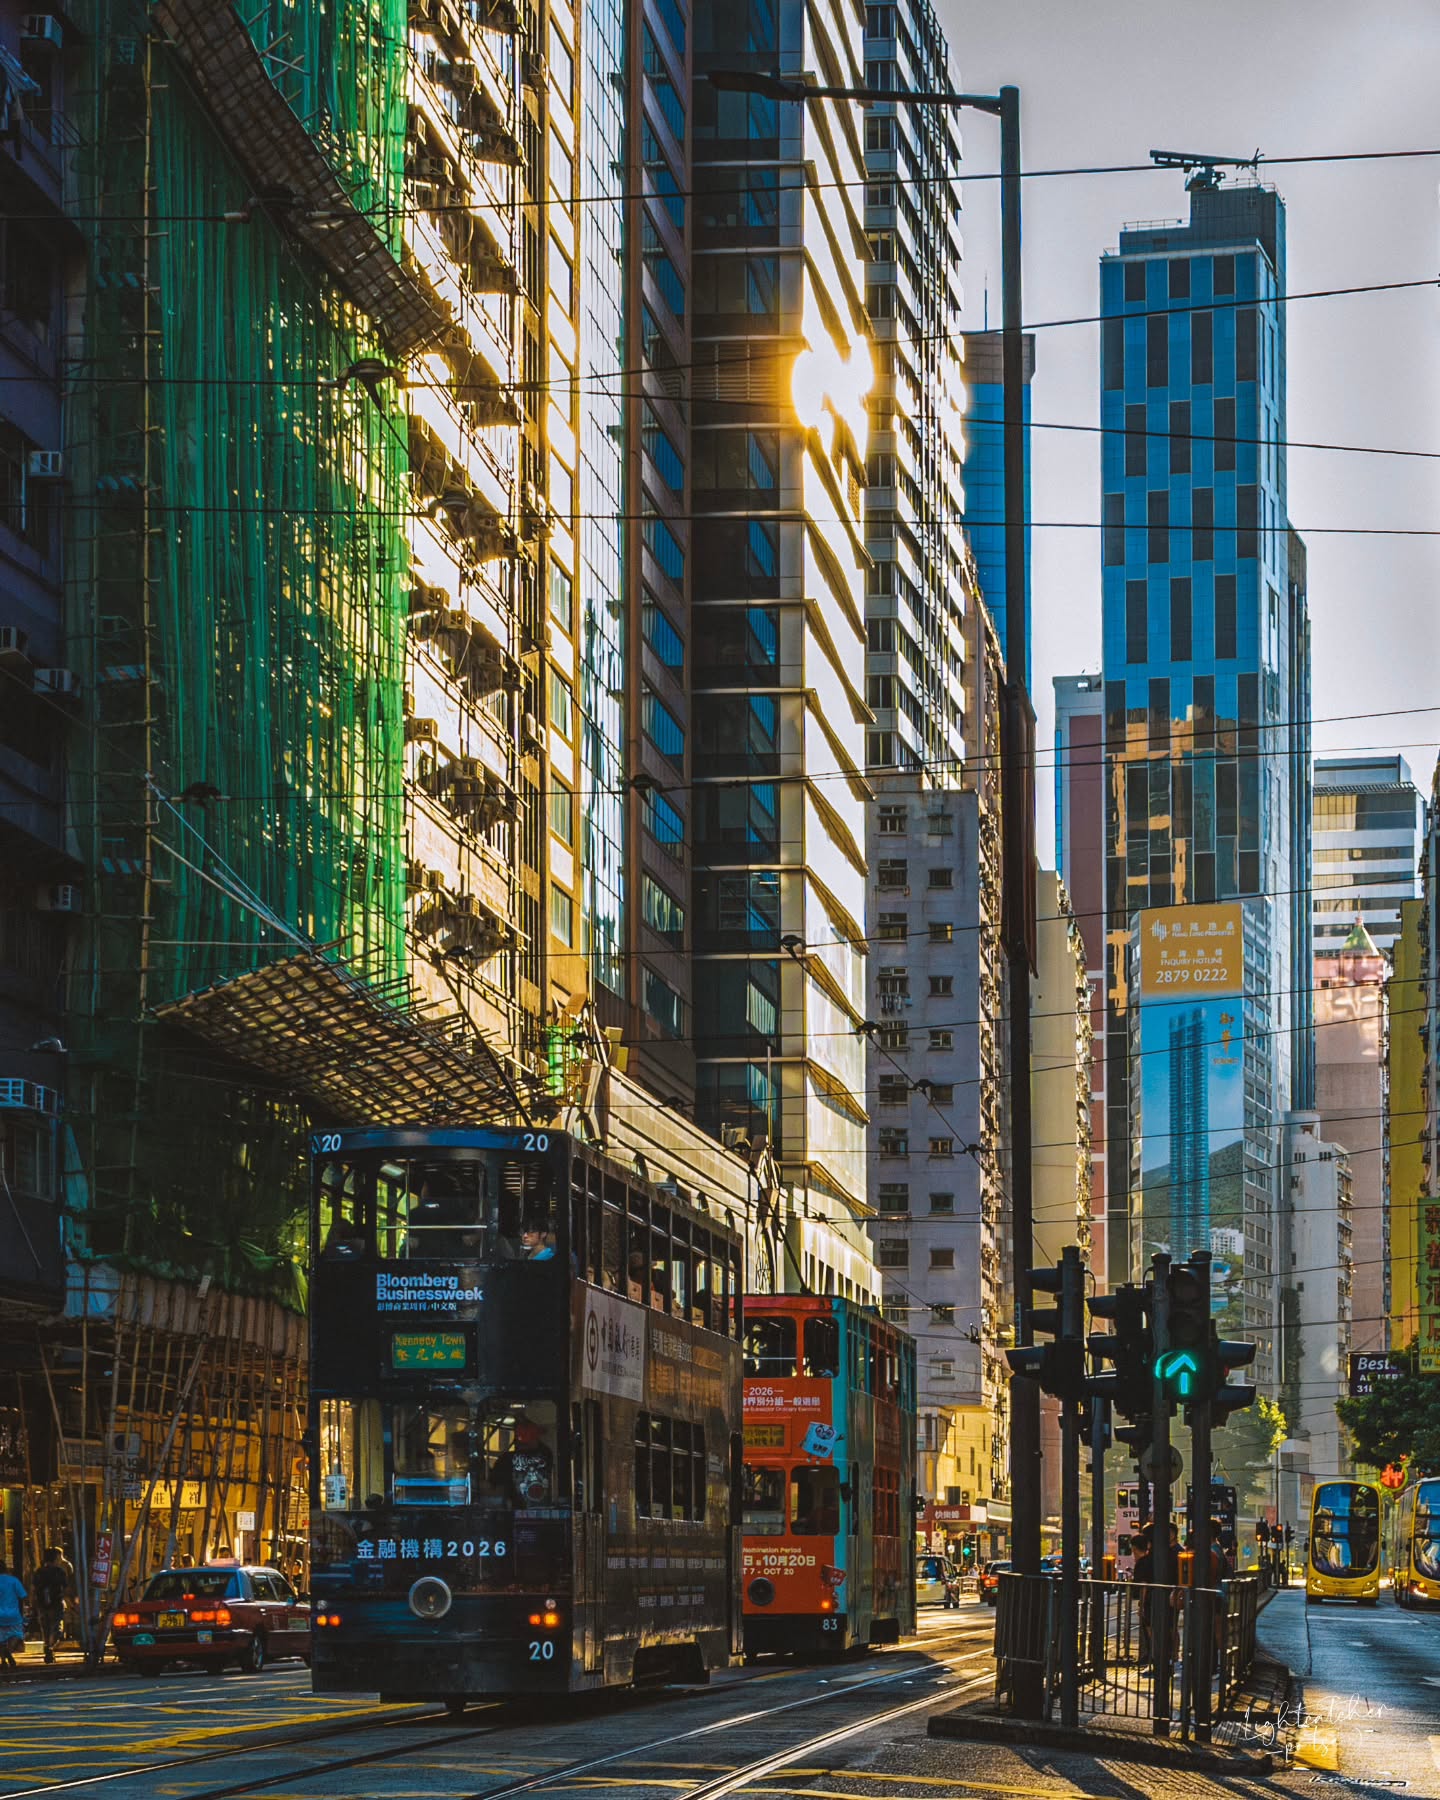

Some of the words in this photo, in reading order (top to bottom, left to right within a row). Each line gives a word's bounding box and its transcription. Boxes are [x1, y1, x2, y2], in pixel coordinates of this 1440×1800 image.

[1156, 970, 1190, 983] 2879
[1194, 968, 1228, 982] 0222
[322, 1134, 342, 1152] 20
[523, 1133, 549, 1152] 20
[376, 1273, 459, 1289] Bloomberg
[376, 1287, 484, 1301] Businessweek
[441, 1334, 465, 1345] Town
[749, 1387, 774, 1396] 2026
[822, 1618, 838, 1630] 83
[529, 1641, 554, 1660] 20
